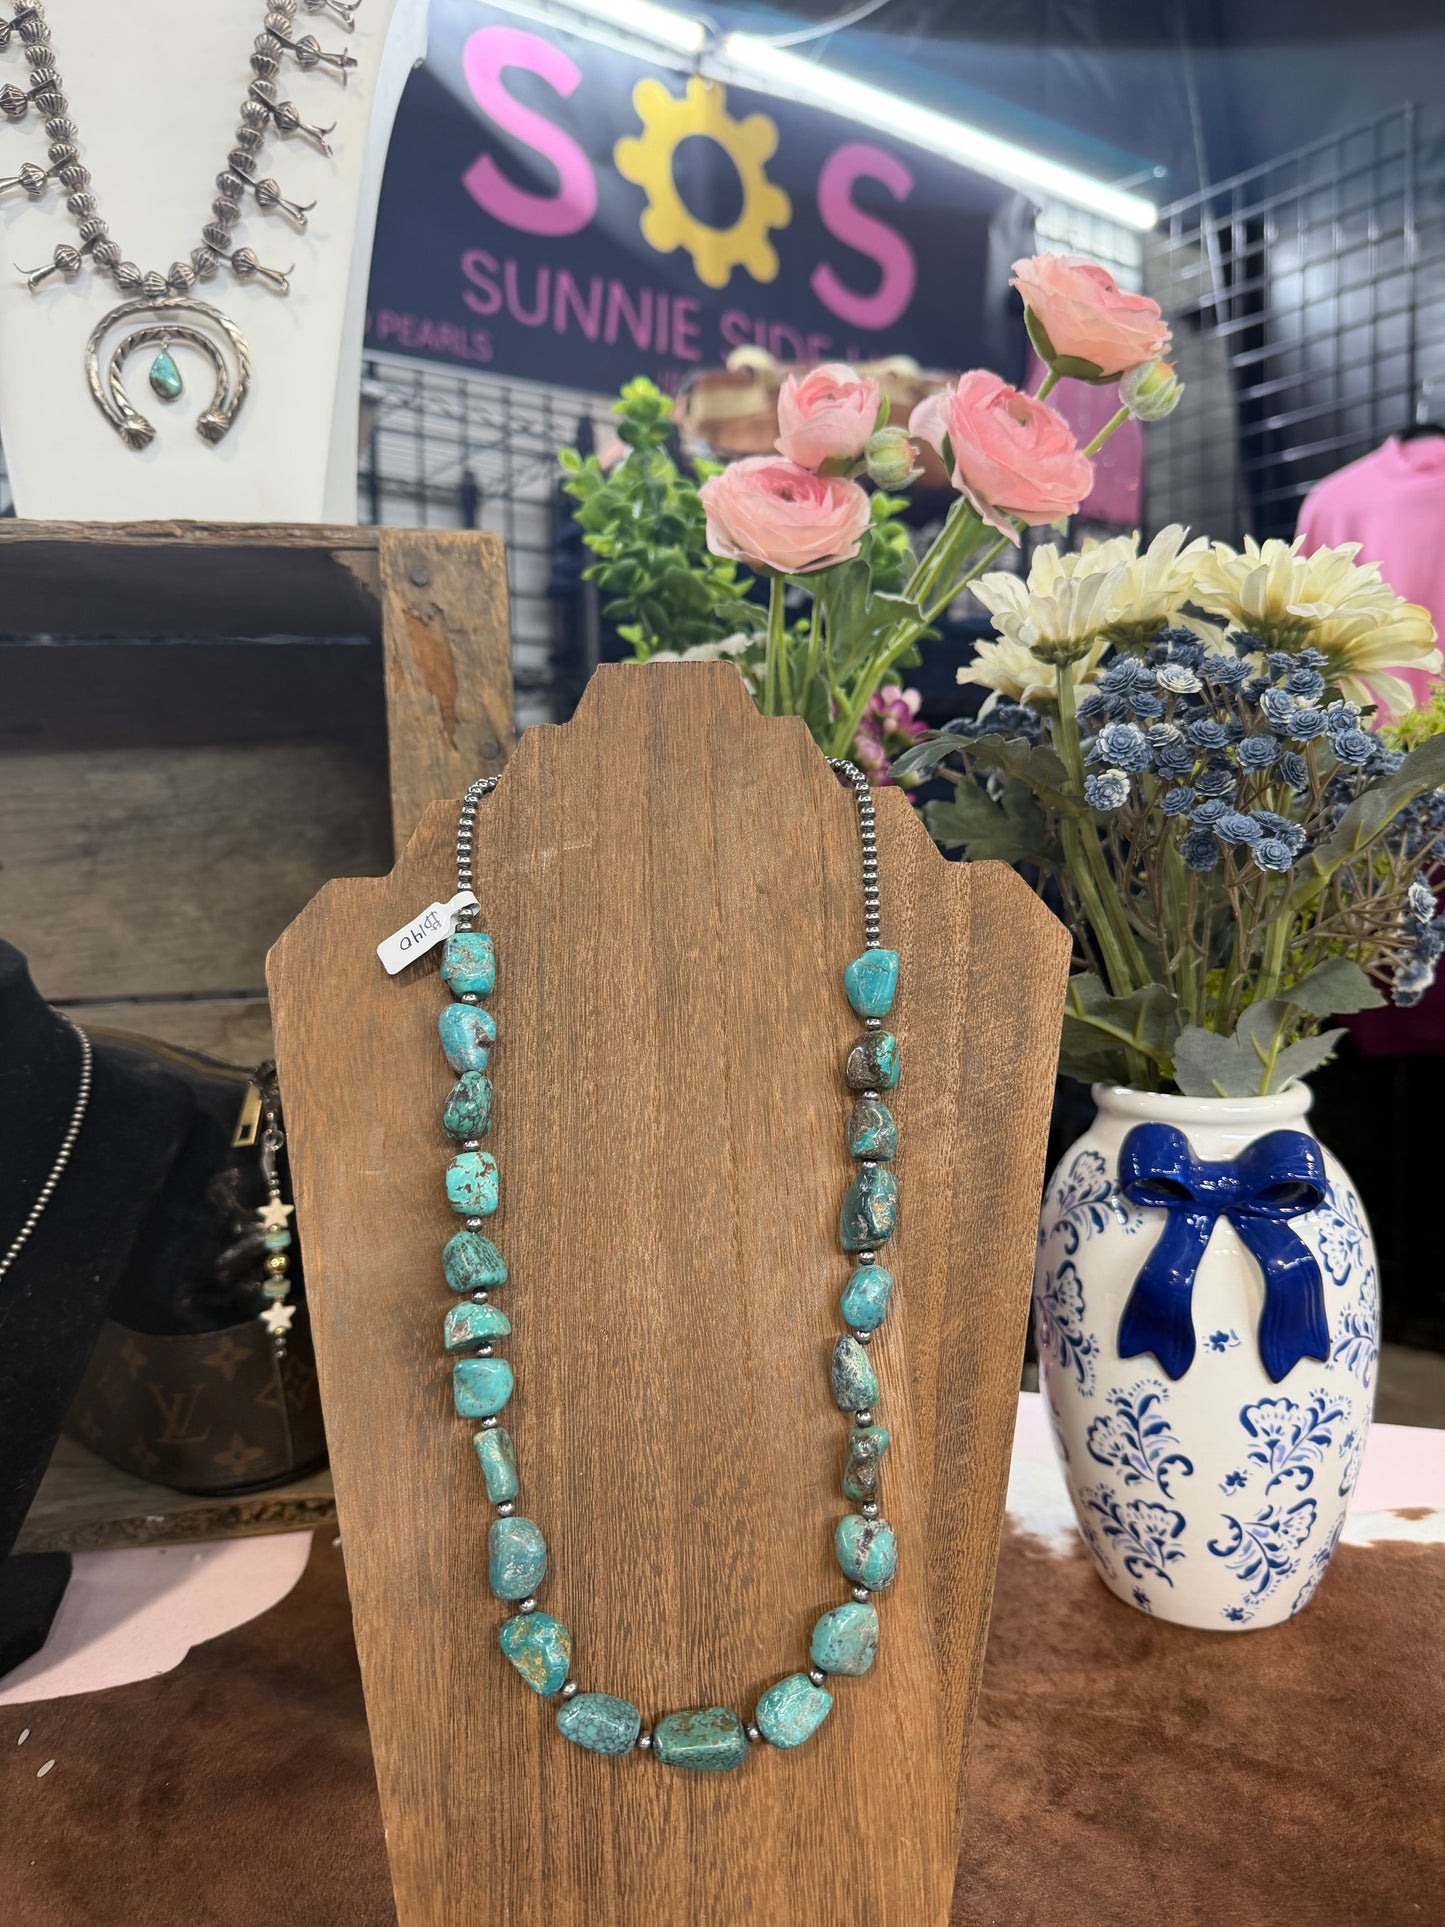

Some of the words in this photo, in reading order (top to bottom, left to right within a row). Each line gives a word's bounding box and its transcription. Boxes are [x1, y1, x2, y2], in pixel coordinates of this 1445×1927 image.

[461, 249, 702, 361] SUNNIE
[376, 309, 494, 363] PEARLS
[399, 911, 442, 951] $140
